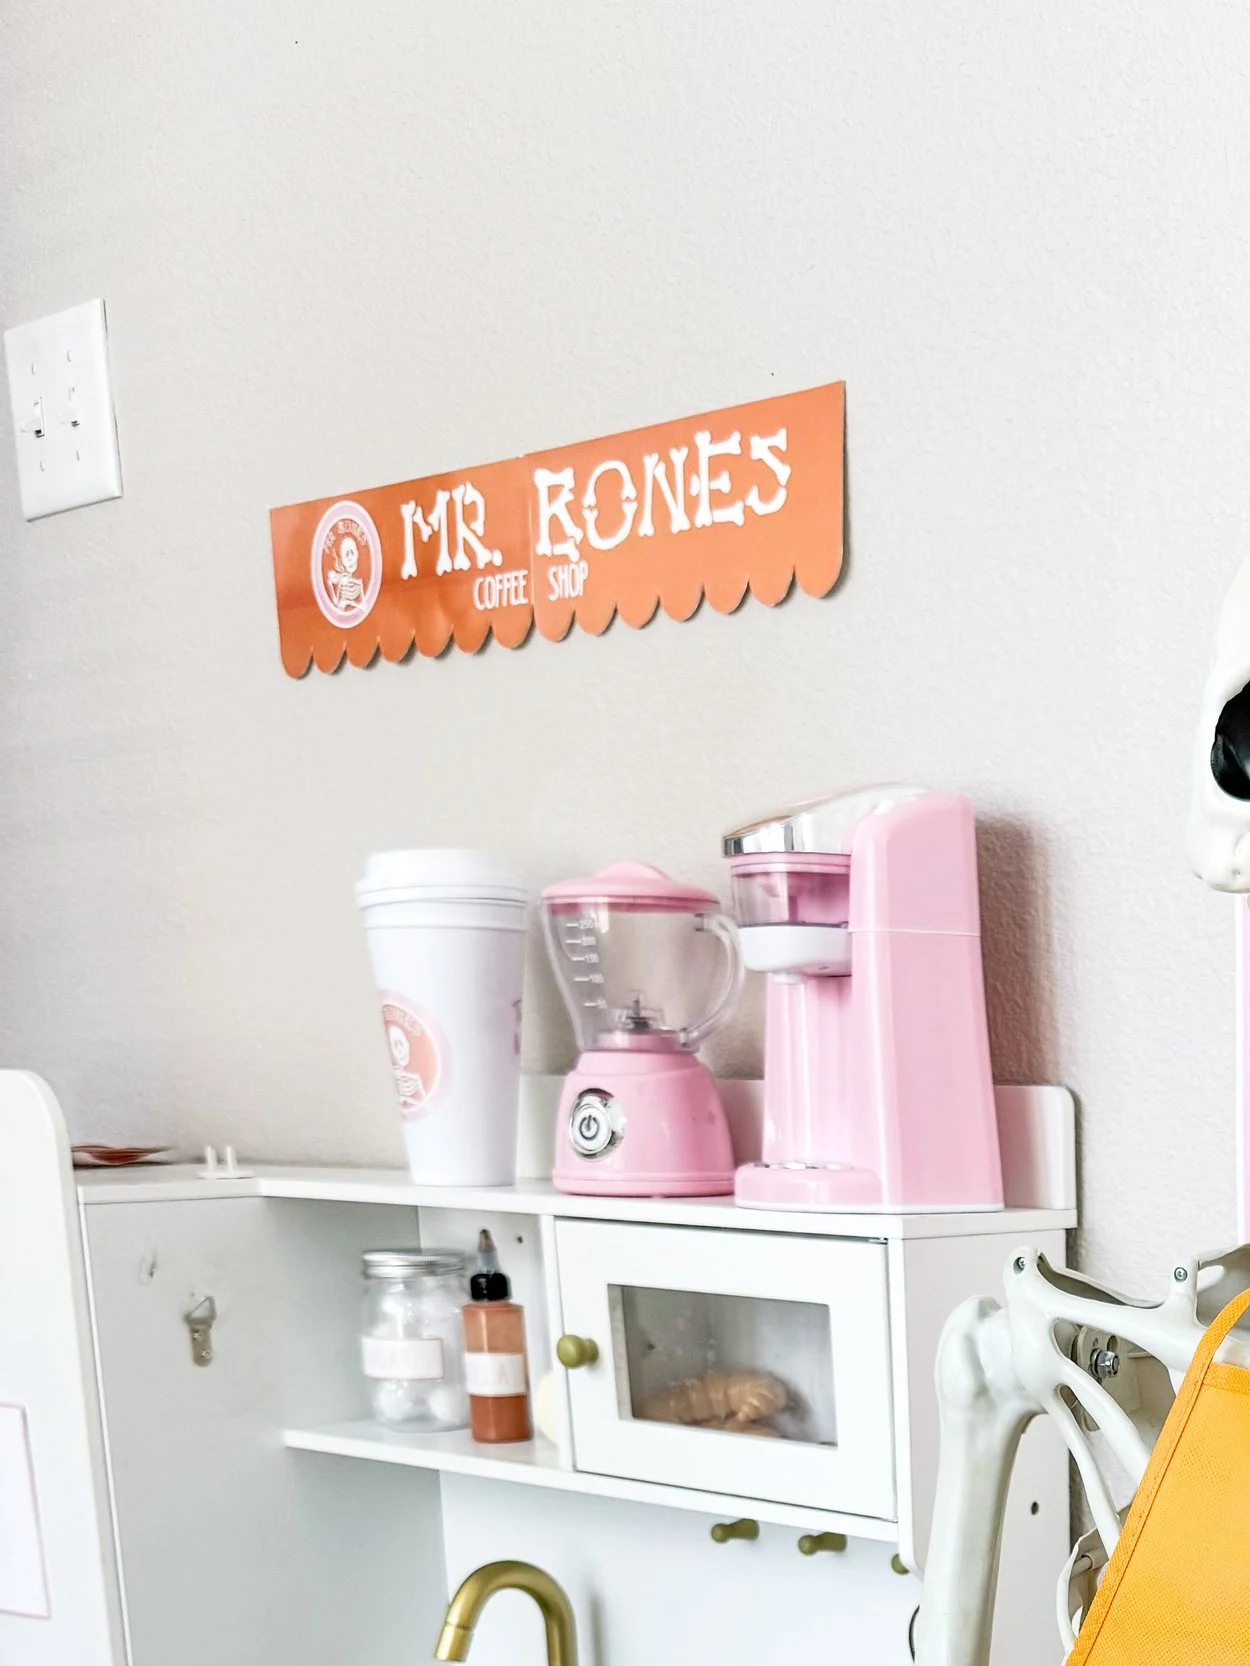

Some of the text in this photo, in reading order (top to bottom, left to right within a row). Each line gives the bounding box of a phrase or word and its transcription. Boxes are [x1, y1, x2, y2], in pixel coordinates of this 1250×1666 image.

[401, 428, 791, 578] MR. BONES
[474, 562, 589, 611] COFFEE SHOP
